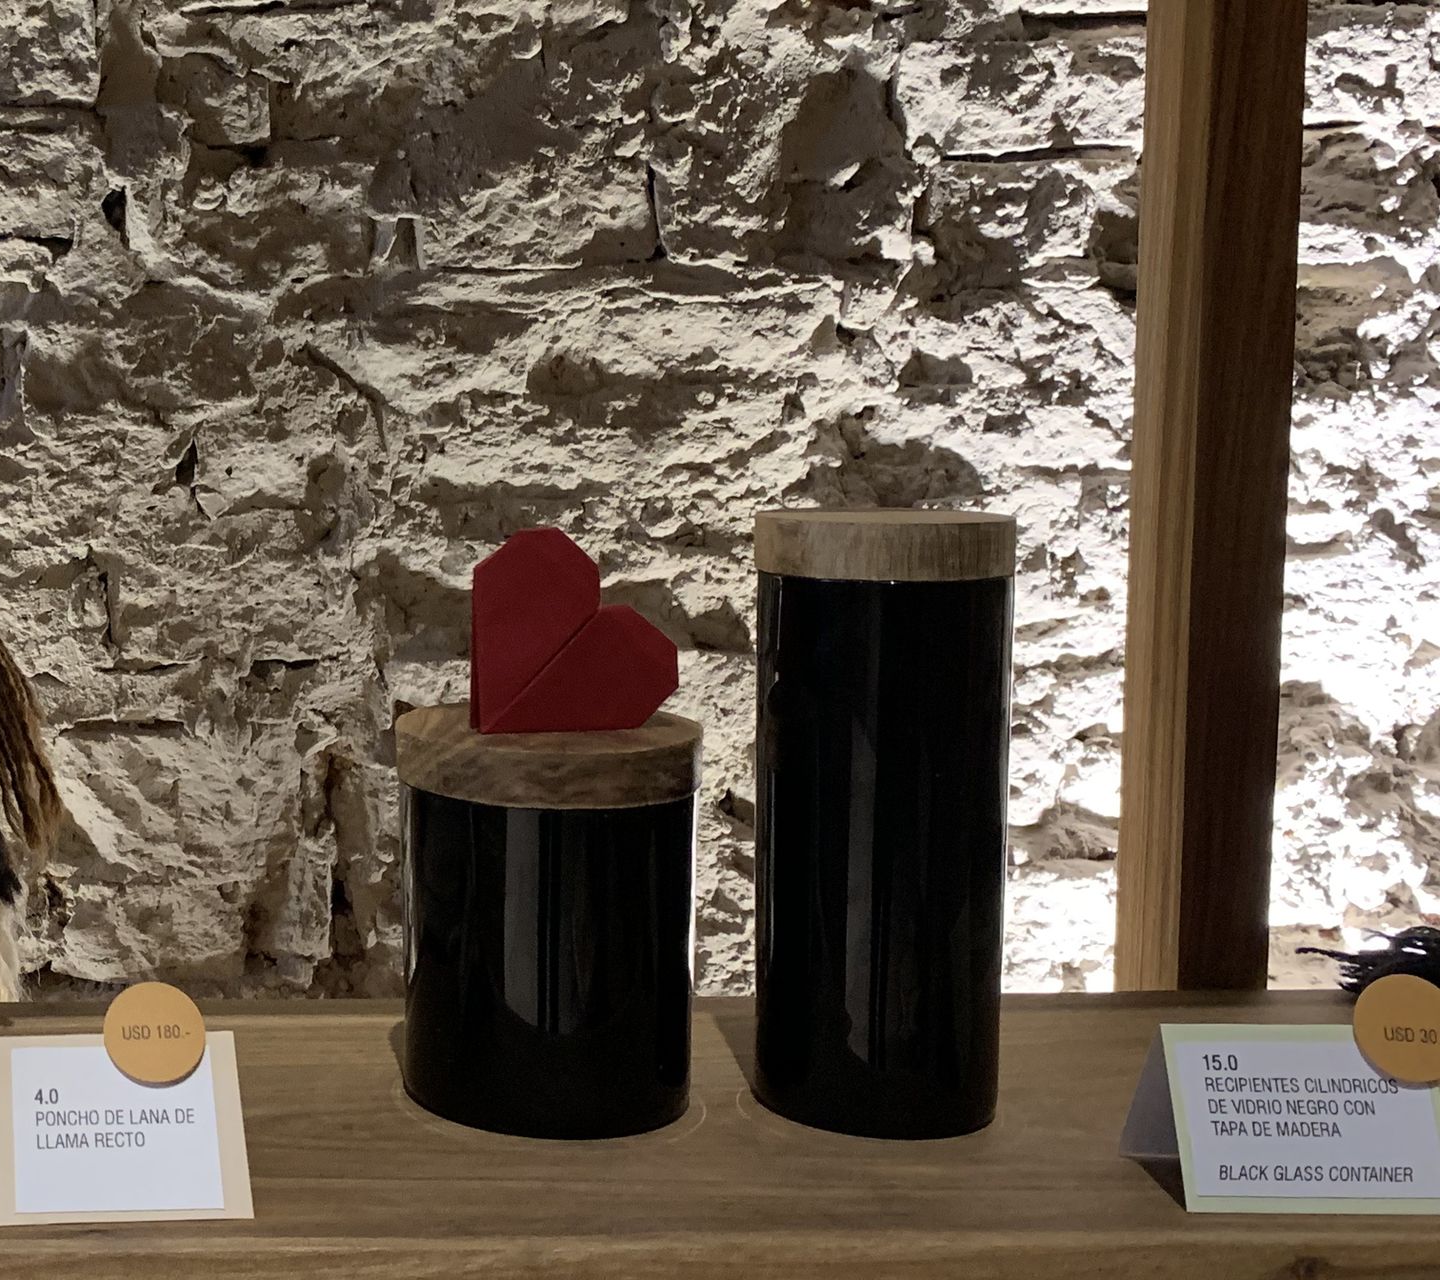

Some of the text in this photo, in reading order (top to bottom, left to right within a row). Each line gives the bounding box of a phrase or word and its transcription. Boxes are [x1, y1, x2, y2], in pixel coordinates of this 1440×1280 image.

[122, 1024, 190, 1040] USD 180.-
[1384, 1027, 1415, 1043] USD
[1203, 1054, 1238, 1071] 15.0
[1205, 1078, 1399, 1094] RECIPIENTES CILINDRICOS
[34, 1088, 58, 1104] 4.0
[1208, 1099, 1376, 1116] DE VIDRIO NEGRO CON
[36, 1108, 194, 1126] PONCHO DE LANA DE
[1211, 1121, 1342, 1137] TAPA DE MADERA
[36, 1132, 146, 1149] LLAMA RECTO
[1219, 1165, 1413, 1183] BLACK GLASS CONTAINER
